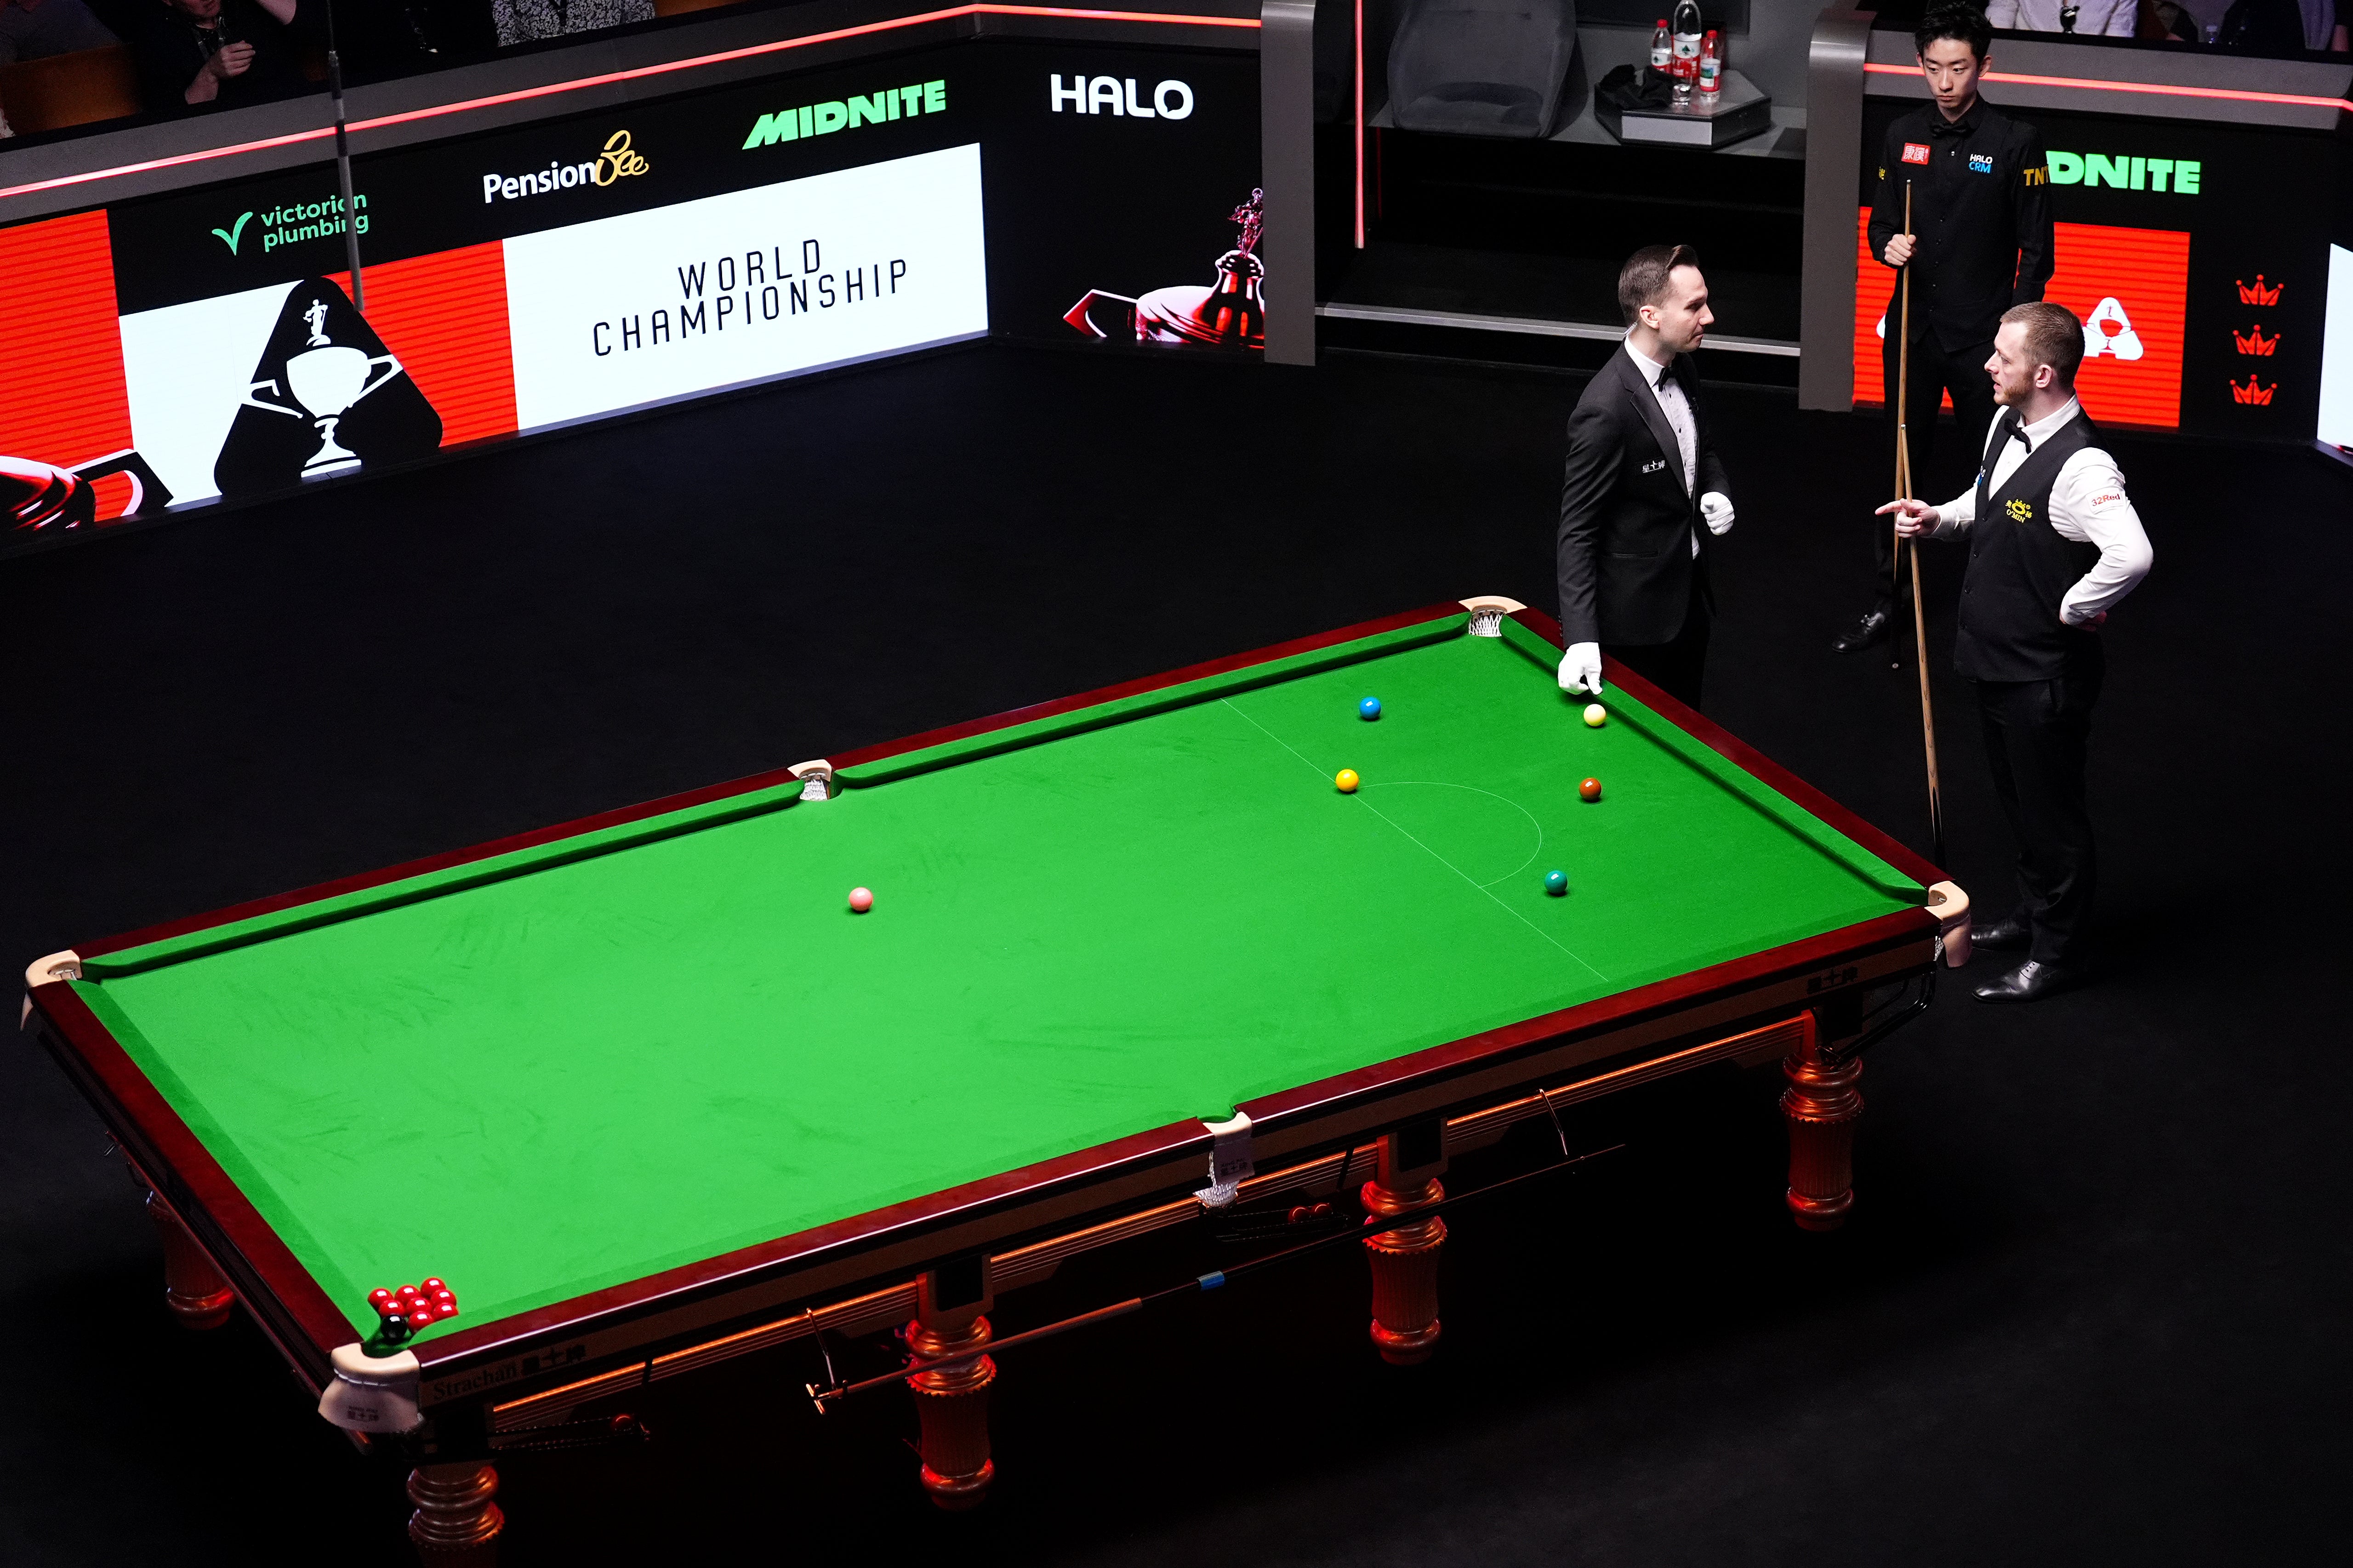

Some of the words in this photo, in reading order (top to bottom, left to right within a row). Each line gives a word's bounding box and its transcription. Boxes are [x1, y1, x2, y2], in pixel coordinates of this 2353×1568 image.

[742, 80, 946, 150] MIDNITE
[1051, 74, 1193, 119] HALO
[484, 130, 649, 204] PensionBee
[1969, 161, 1991, 174] CRM
[1970, 153, 1993, 164] HALO
[678, 239, 820, 300] WORLD
[593, 259, 906, 356] CHAMPIONSHIP
[2006, 509, 2025, 523] O'MIN
[2091, 494, 2120, 506] 32Red
[433, 1363, 518, 1401] Strachan
